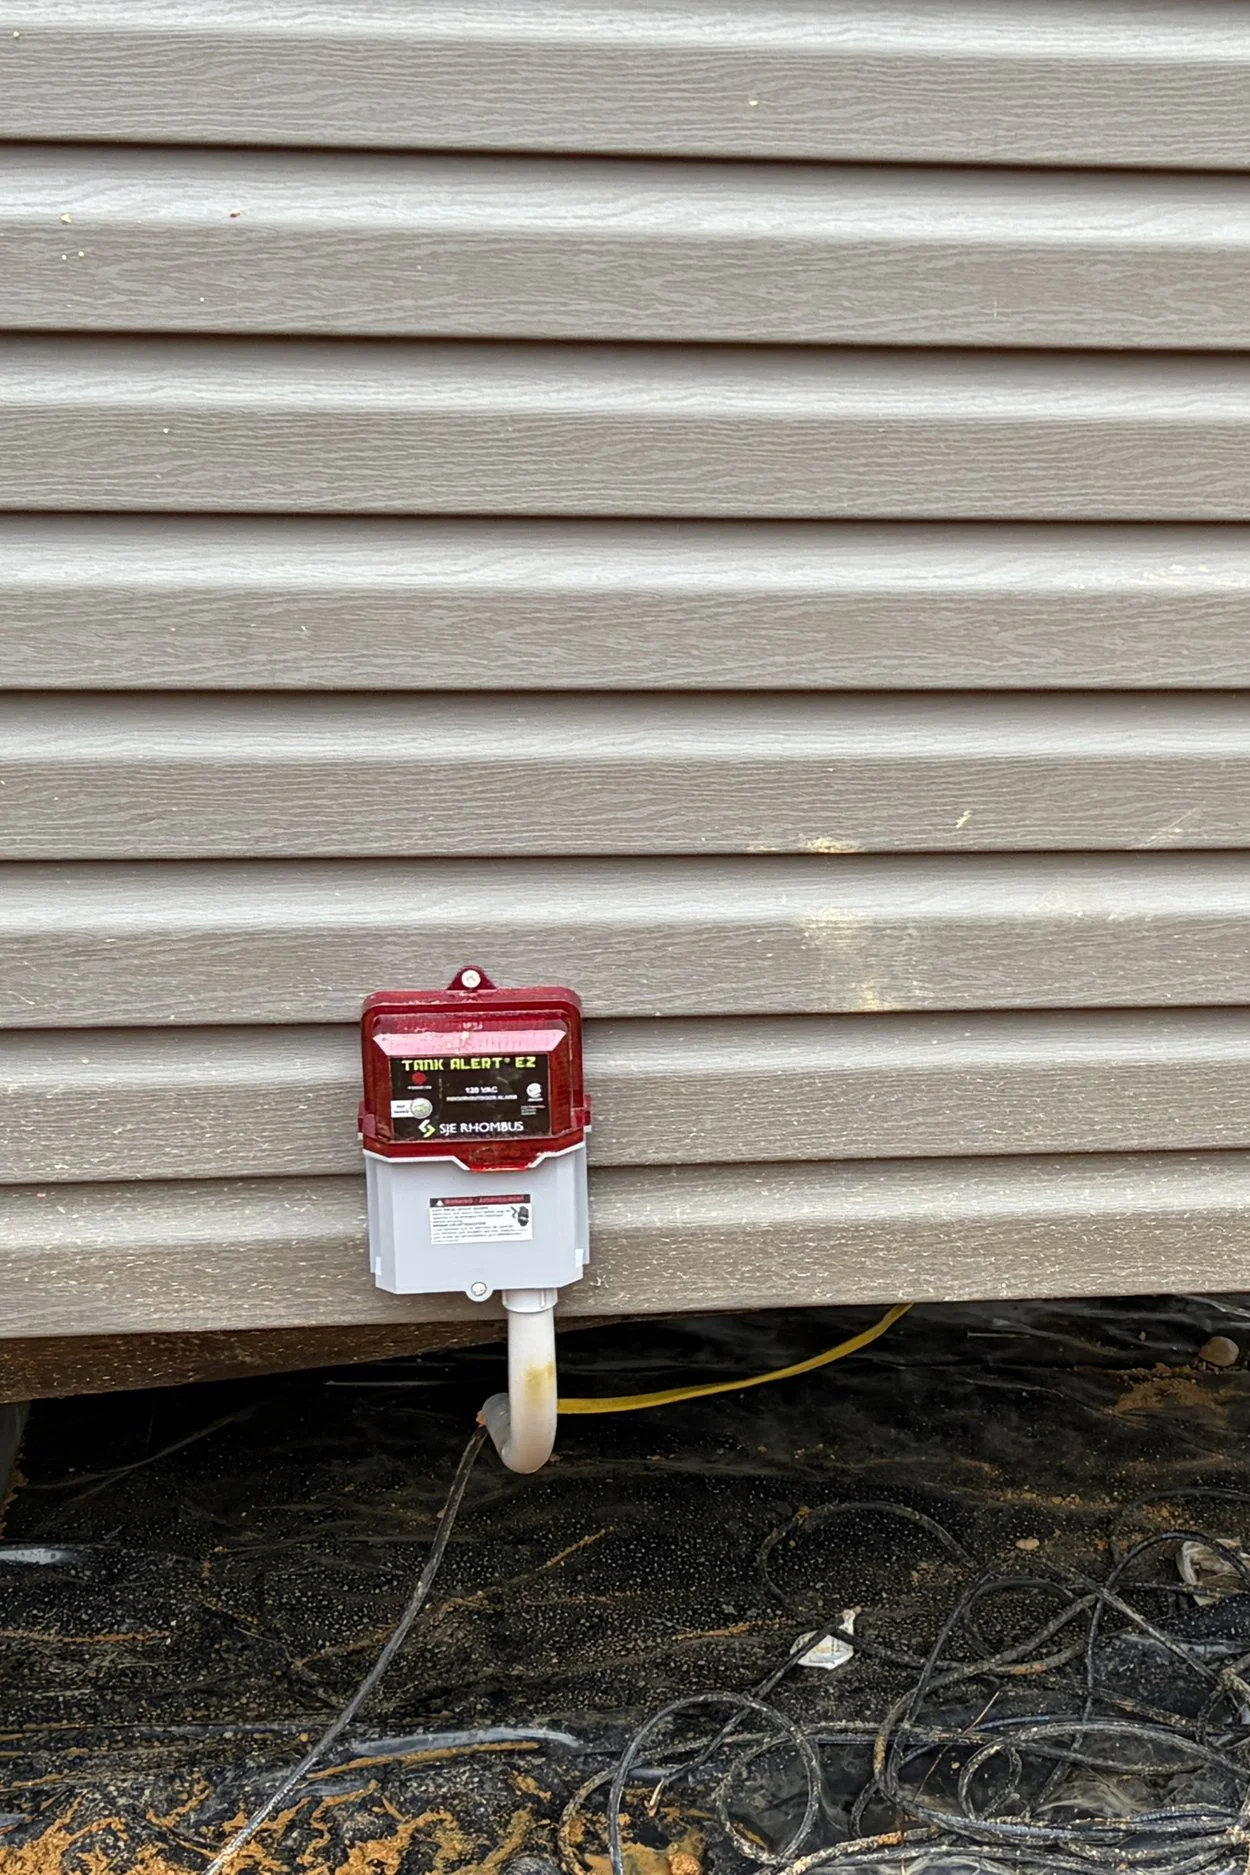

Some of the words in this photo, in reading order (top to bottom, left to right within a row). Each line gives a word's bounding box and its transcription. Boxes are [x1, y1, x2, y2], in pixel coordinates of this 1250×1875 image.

[401, 1059, 444, 1071] TANK
[515, 1056, 537, 1068] EZ
[439, 1123, 457, 1136] SJE
[460, 1121, 524, 1133] RHOMBUS
